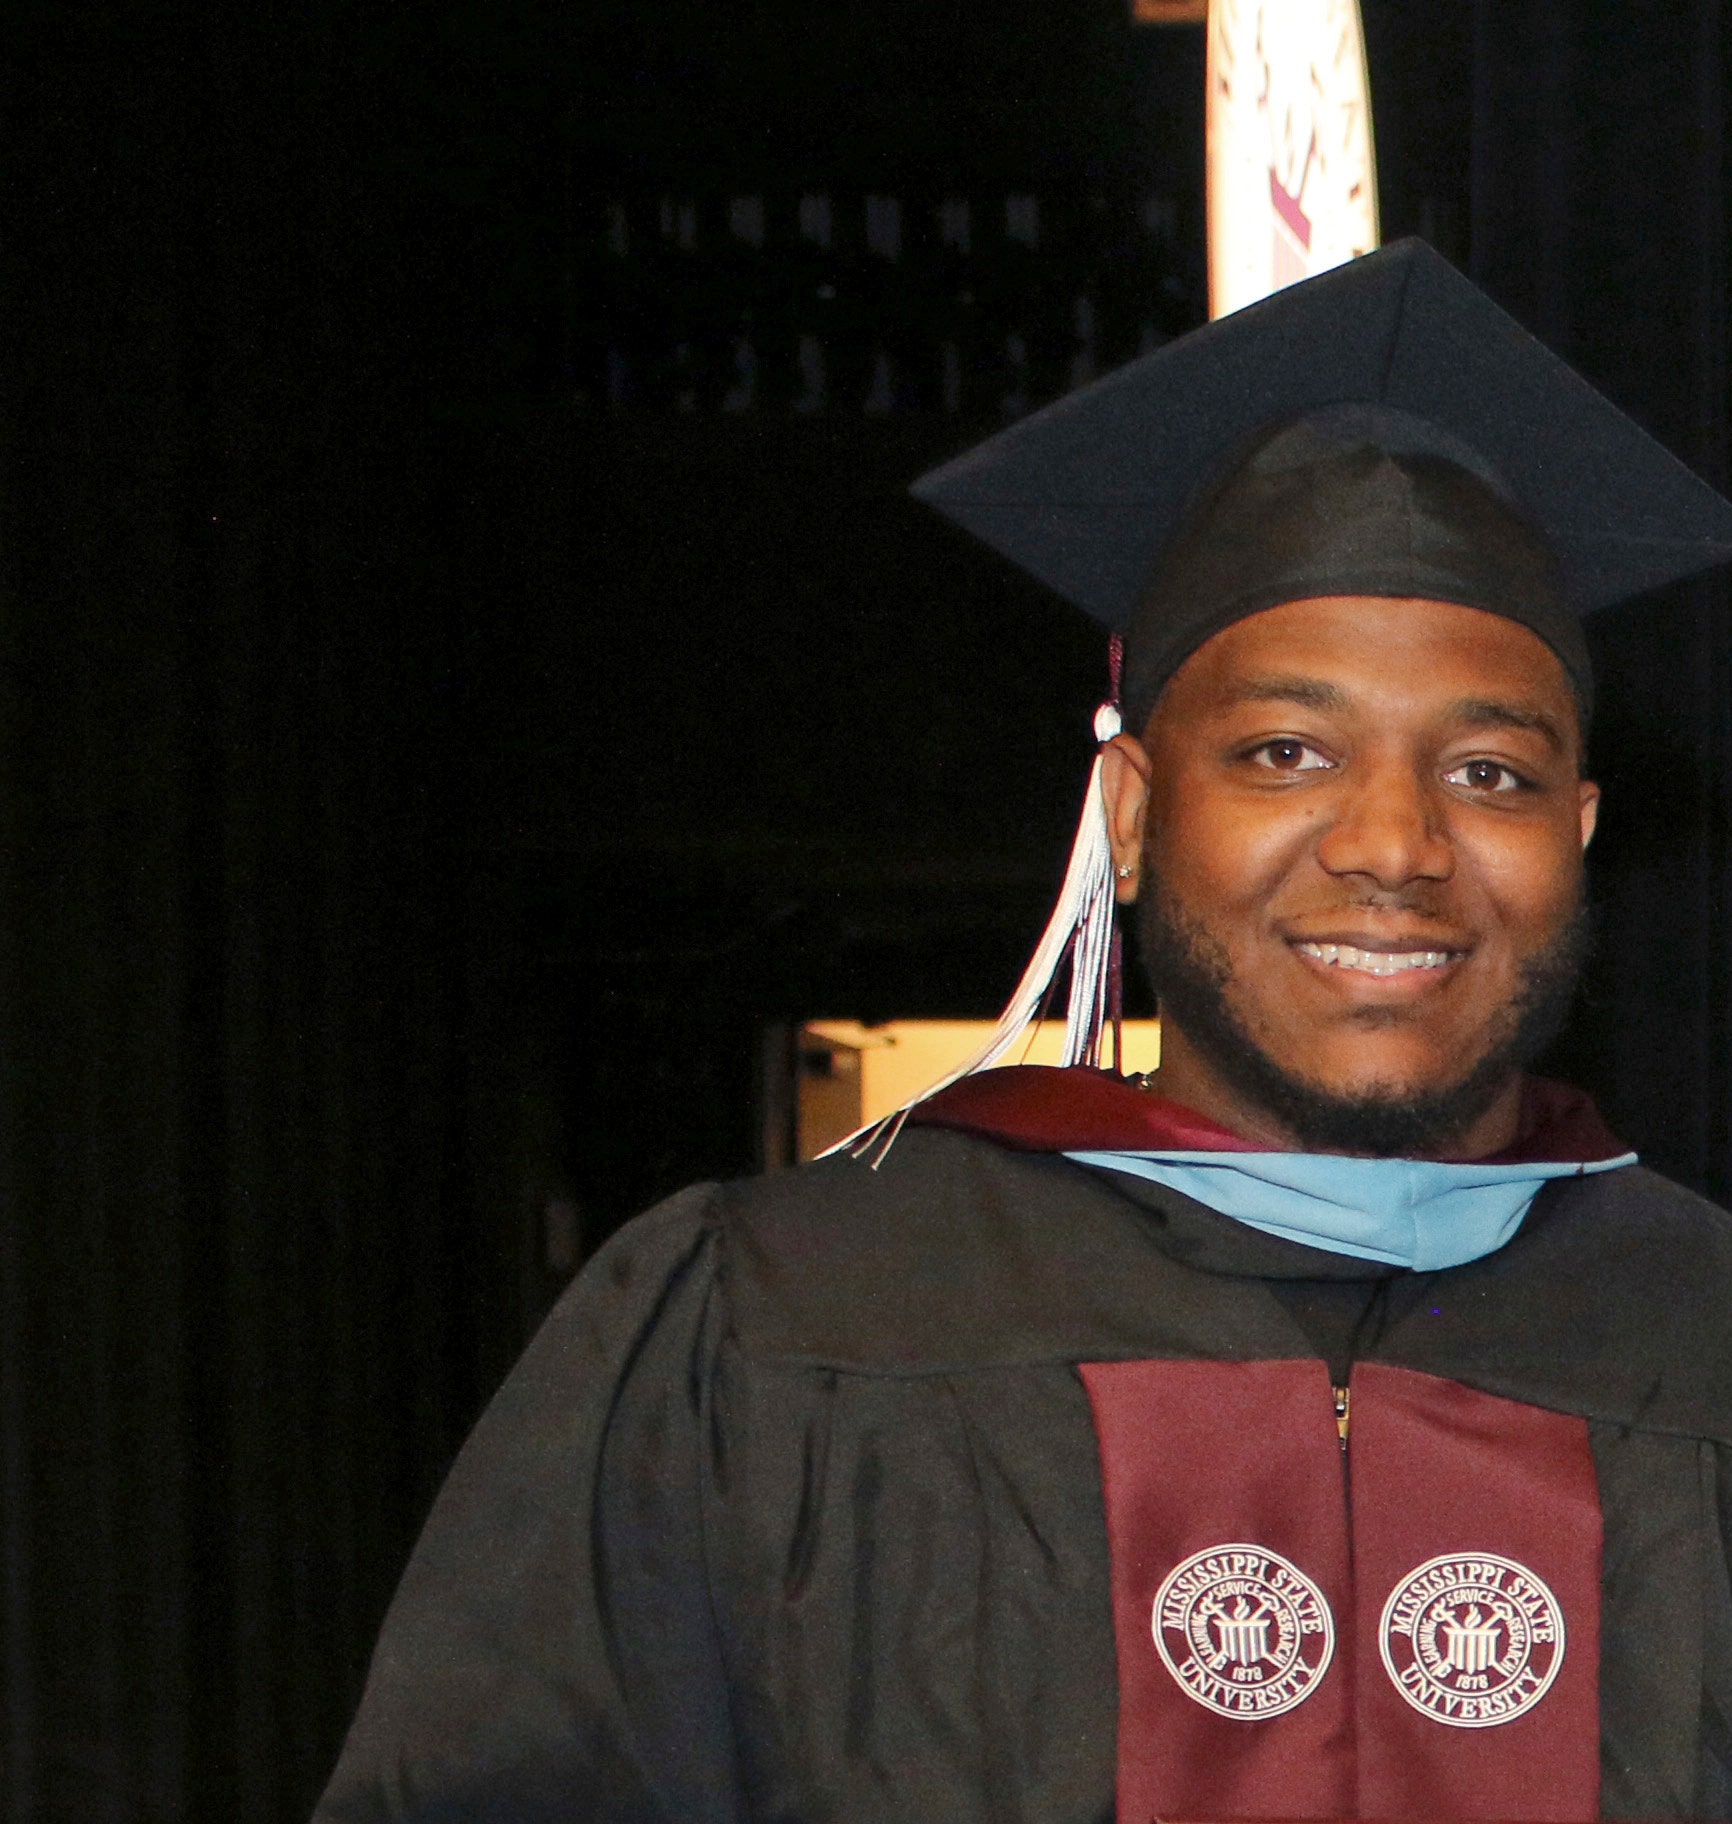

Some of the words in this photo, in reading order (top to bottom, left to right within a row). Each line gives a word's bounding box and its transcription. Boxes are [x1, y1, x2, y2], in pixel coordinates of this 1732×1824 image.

[1163, 1554, 1270, 1630] MISSISSIPPI
[1272, 1569, 1323, 1634] STATE
[1213, 1581, 1261, 1600] SERVICE
[1391, 1563, 1506, 1637] MISSISSIPPI
[1507, 1577, 1554, 1643] STATE
[1447, 1589, 1495, 1607] SERVICE
[1179, 1656, 1315, 1710] UNIVERSITY
[1232, 1666, 1263, 1681] 1878
[1400, 1662, 1542, 1718] UNIVERSITY
[1456, 1674, 1489, 1689] 1878
